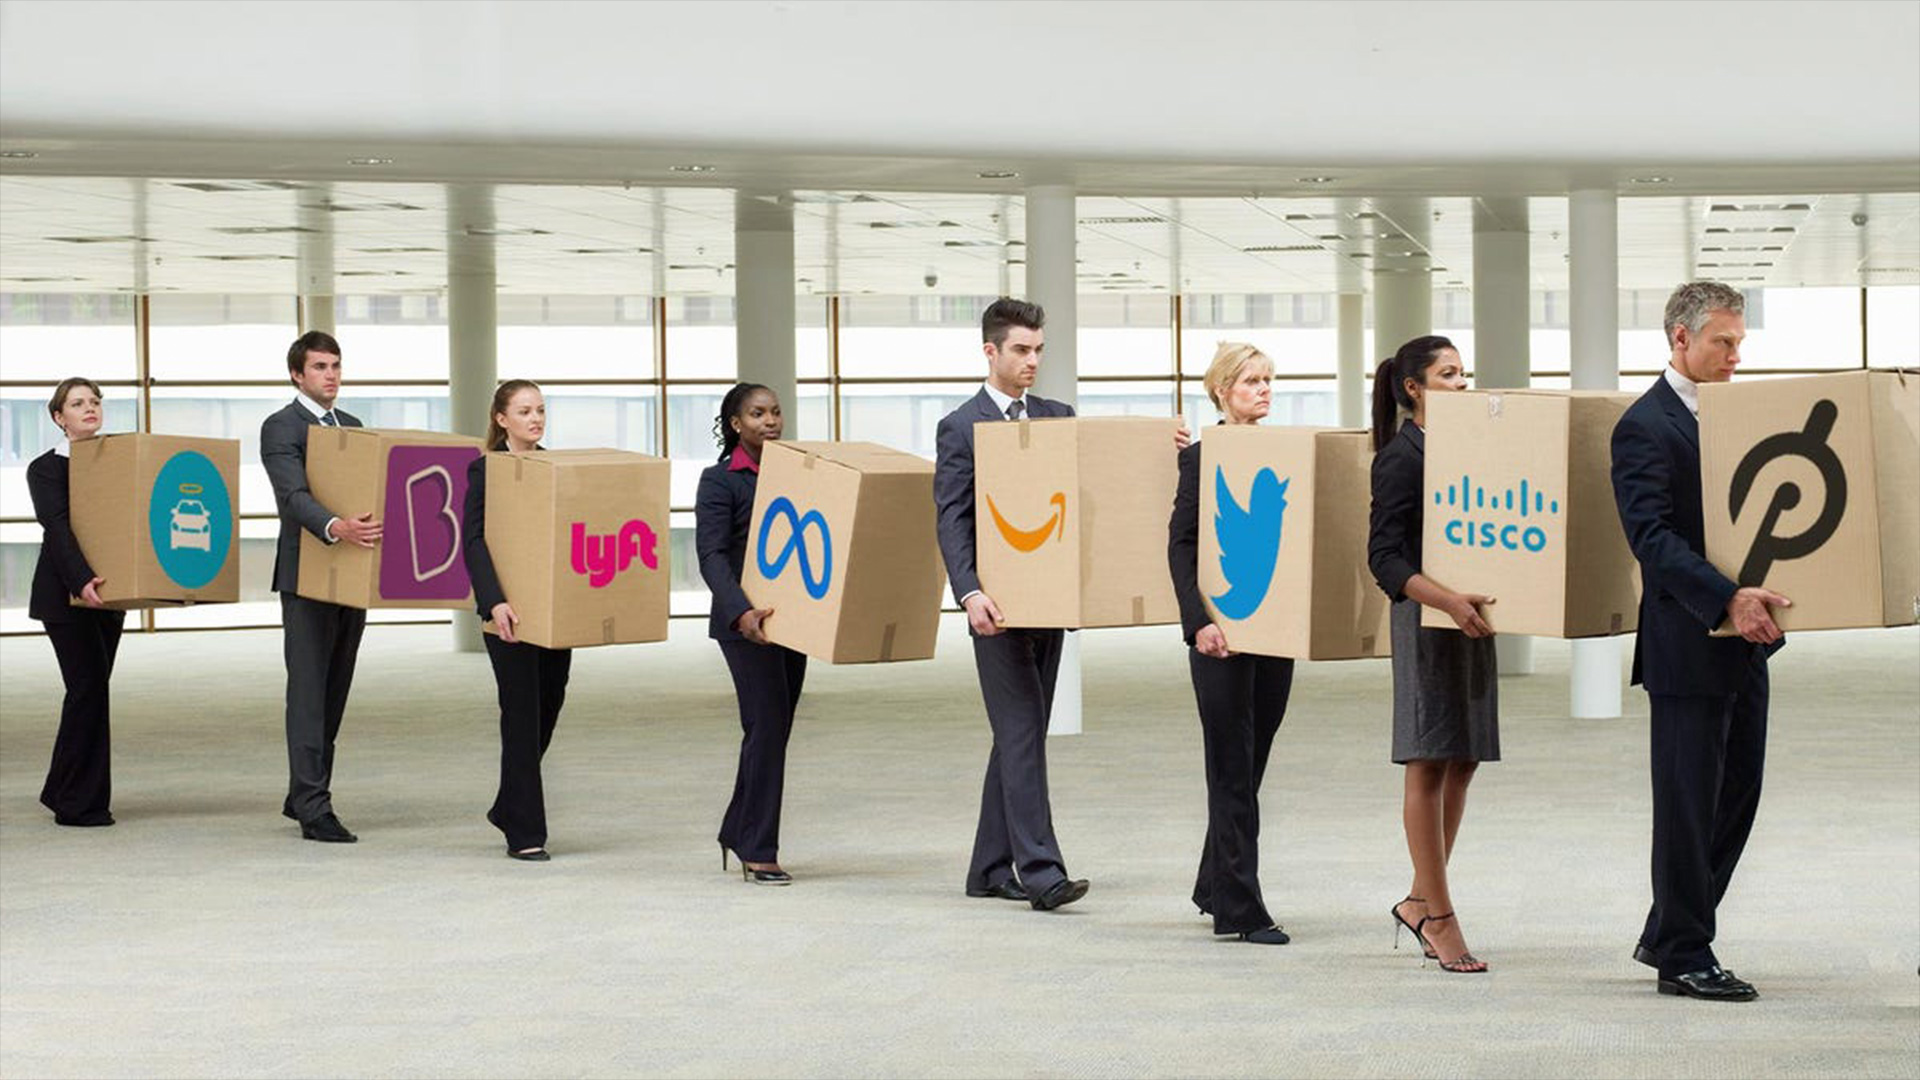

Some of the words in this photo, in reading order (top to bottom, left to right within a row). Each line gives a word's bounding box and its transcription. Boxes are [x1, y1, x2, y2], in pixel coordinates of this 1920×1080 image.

[406, 465, 460, 582] B
[570, 518, 658, 588] lyft
[1445, 520, 1546, 552] CISCO
